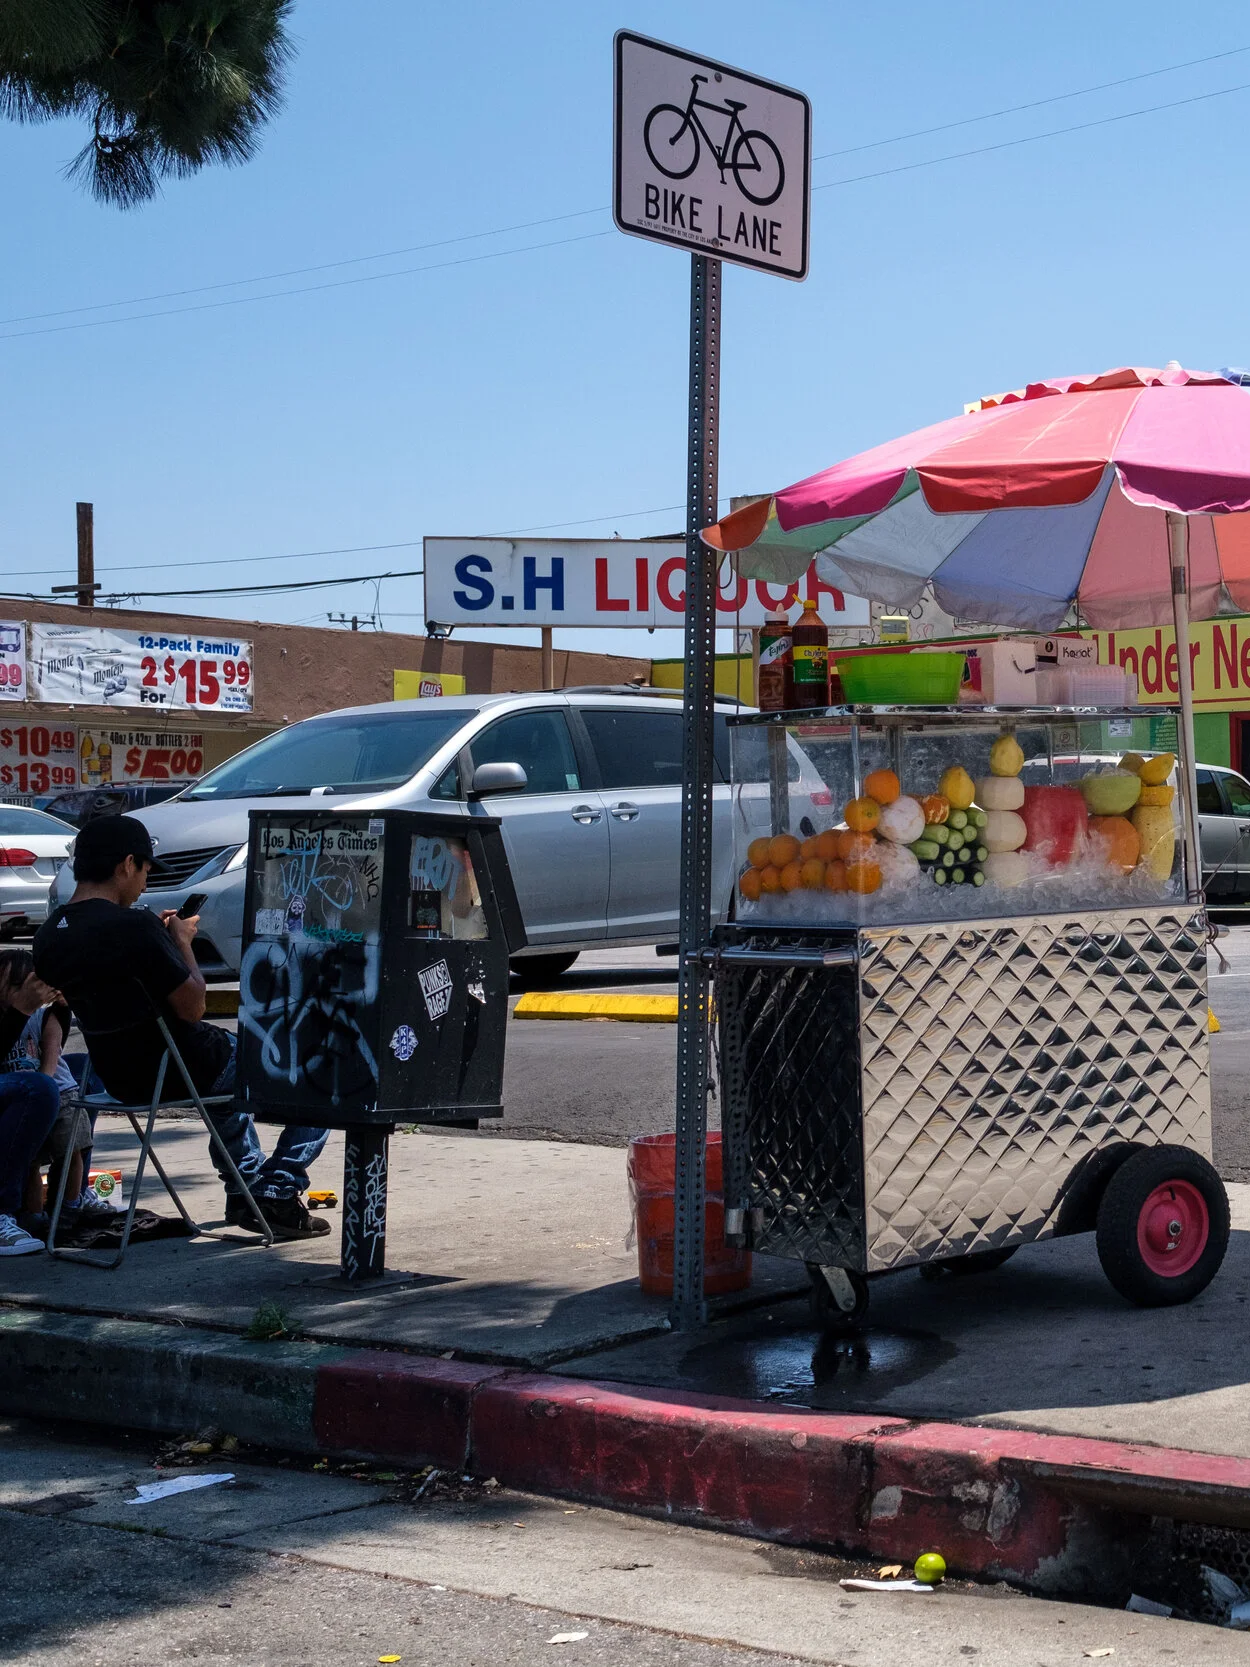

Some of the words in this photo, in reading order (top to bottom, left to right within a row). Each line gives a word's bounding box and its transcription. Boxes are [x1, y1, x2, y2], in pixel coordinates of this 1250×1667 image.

[645, 183, 703, 234] BIKE
[717, 205, 782, 256] LANE
[453, 554, 564, 612] S.H
[138, 636, 192, 652] 12-Pack
[196, 640, 240, 657] Family
[140, 656, 158, 687] 2
[140, 690, 167, 704] For
[155, 734, 182, 747] BOTTLES
[184, 735, 189, 747] 2
[262, 831, 284, 849] Los
[338, 832, 378, 851] Times
